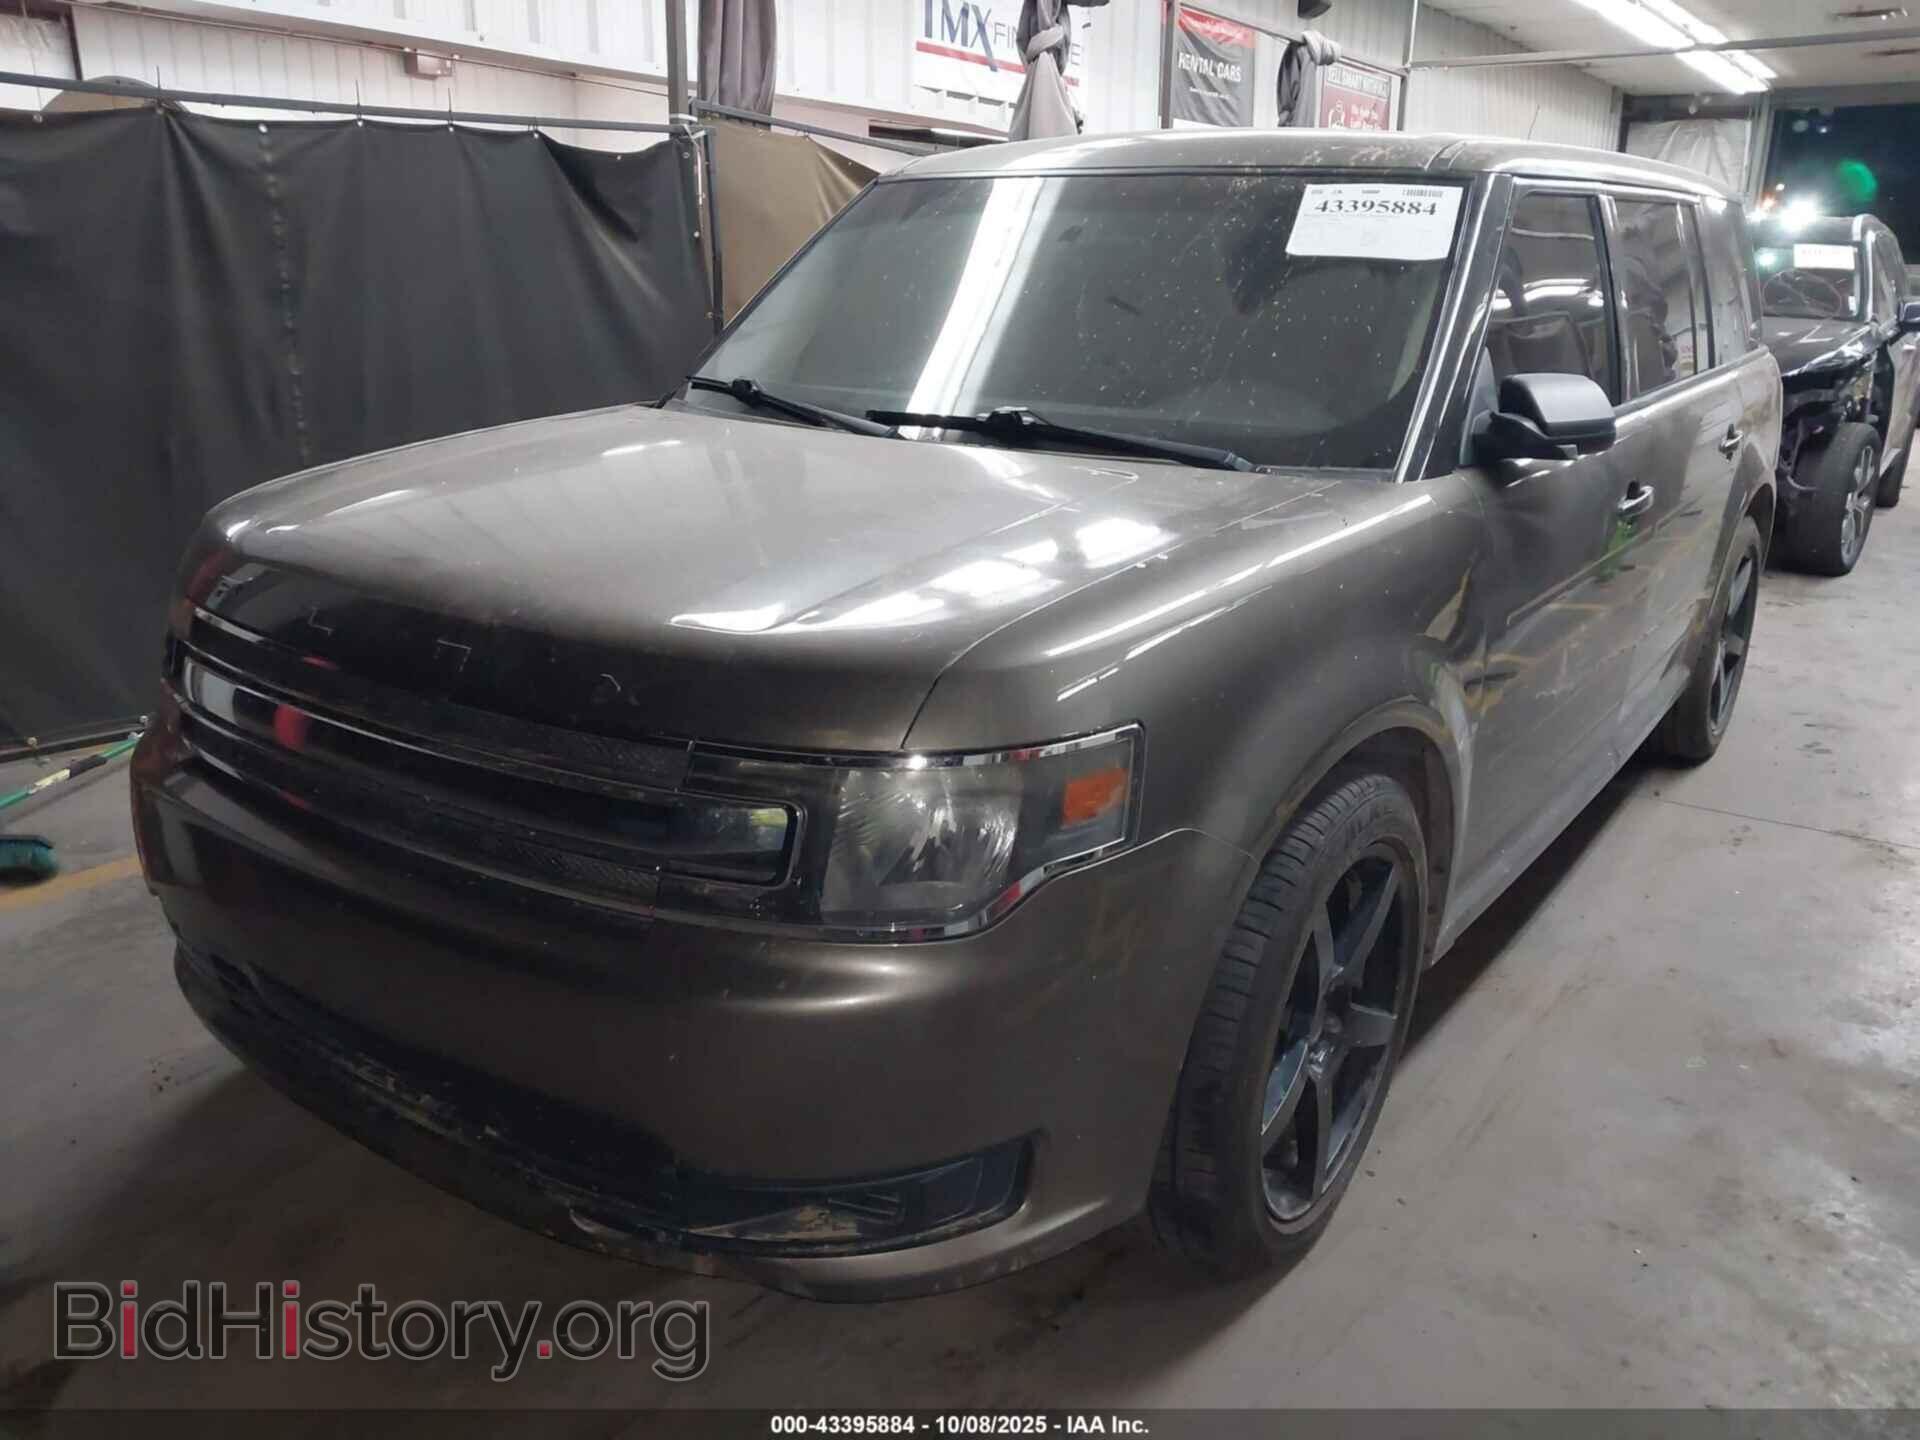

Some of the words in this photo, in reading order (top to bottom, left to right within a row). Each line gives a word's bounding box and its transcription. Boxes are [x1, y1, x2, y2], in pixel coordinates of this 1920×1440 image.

[1178, 52, 1214, 77] RENTAL
[1217, 61, 1241, 82] CARS
[1314, 199, 1437, 216] 43395884
